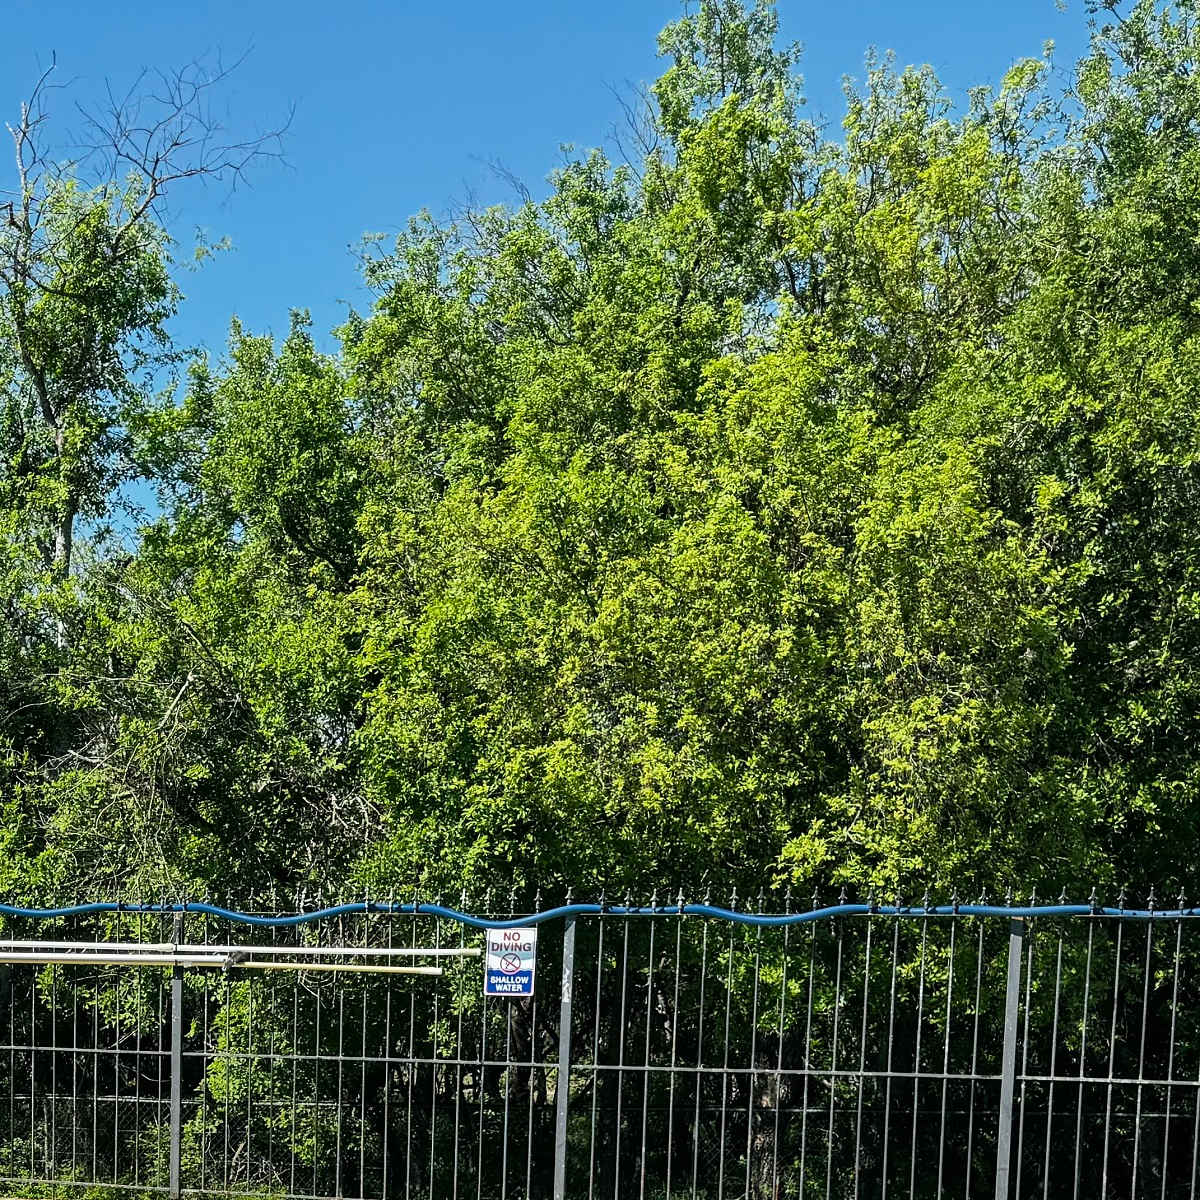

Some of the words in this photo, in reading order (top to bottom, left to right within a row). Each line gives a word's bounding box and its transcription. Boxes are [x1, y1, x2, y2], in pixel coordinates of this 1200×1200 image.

[503, 932, 521, 941] NO
[491, 942, 531, 951] DIVING
[490, 976, 529, 984] SHALLOW
[495, 984, 523, 992] WATER
